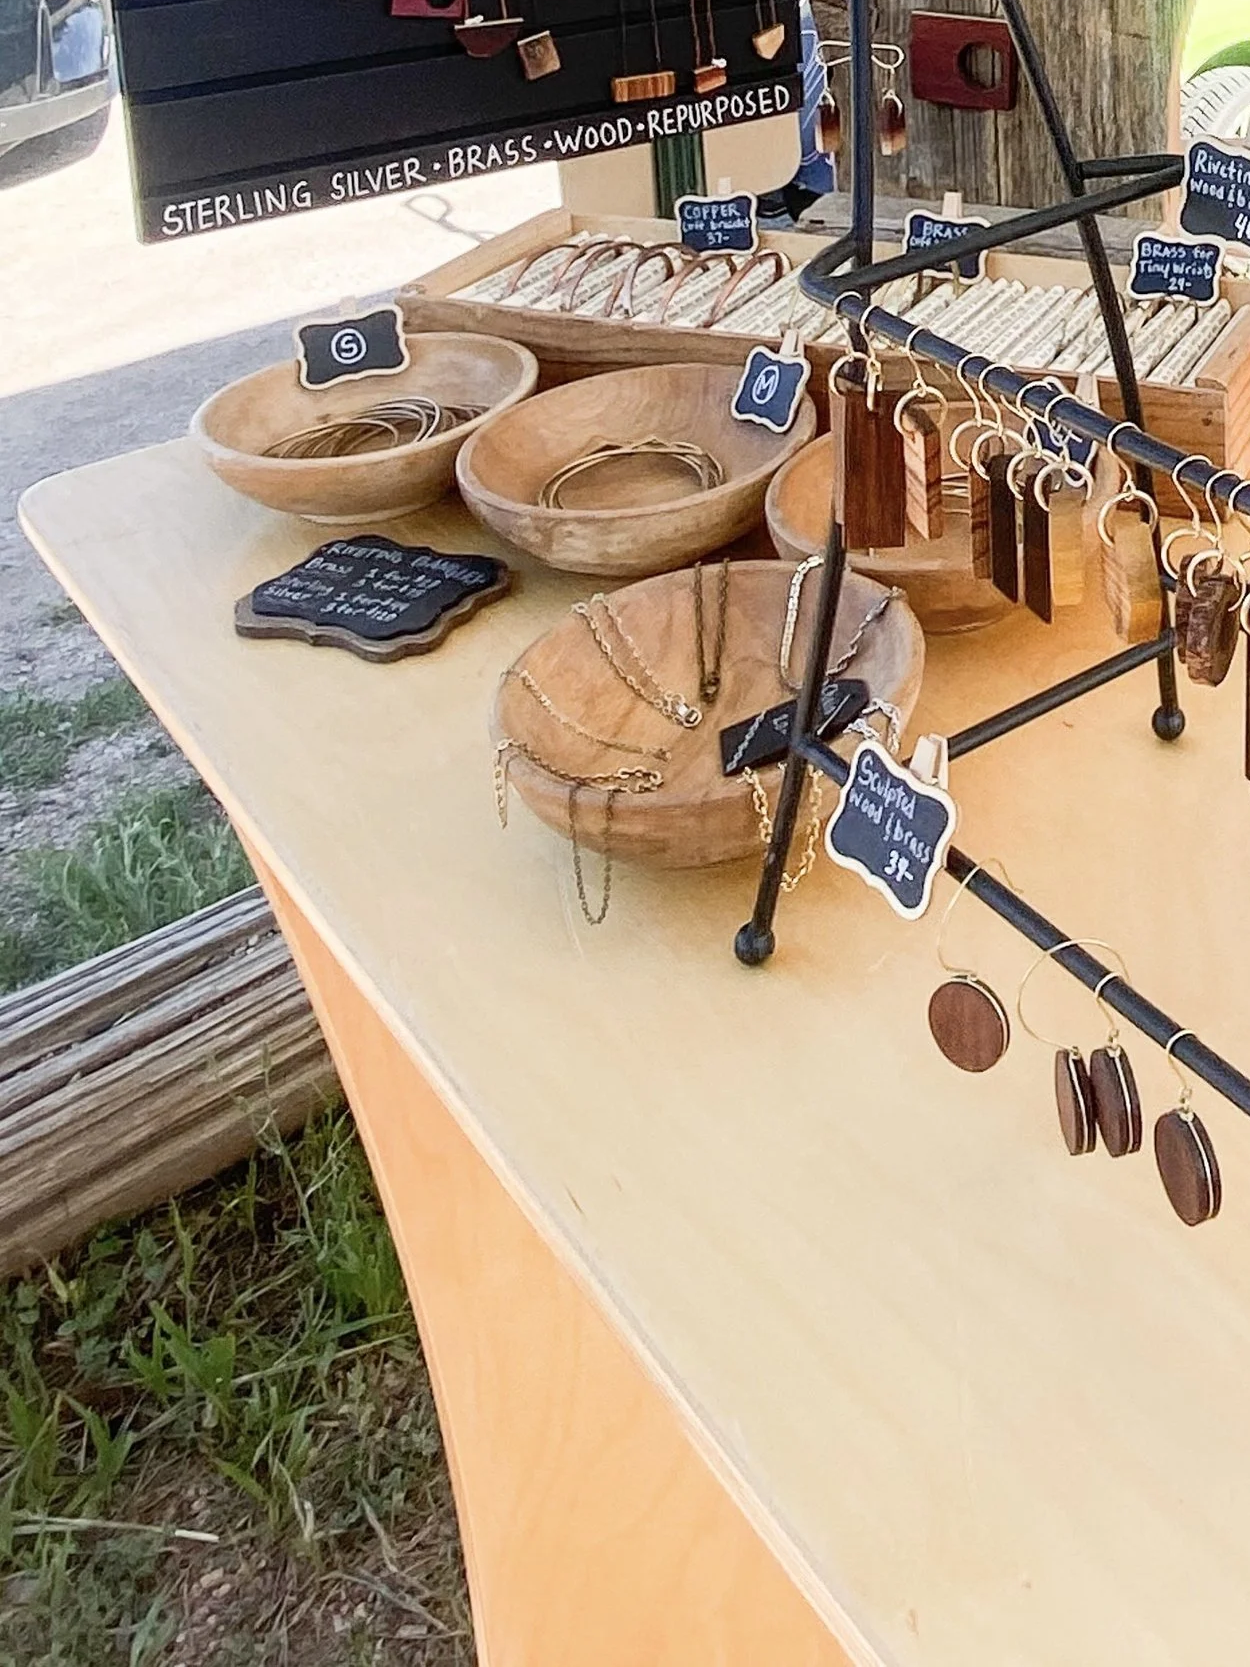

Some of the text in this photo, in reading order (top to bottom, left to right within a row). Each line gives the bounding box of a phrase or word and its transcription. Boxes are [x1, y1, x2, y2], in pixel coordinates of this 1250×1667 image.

[162, 85, 791, 236] STERLING SILVER BRASS WOOD REPURPOSED
[684, 203, 741, 220] COPPER
[923, 221, 968, 239] BRASS
[1141, 242, 1187, 259] BRASS
[1139, 260, 1171, 279] Tiny
[857, 754, 916, 820] Sculpted
[892, 818, 931, 864] brass
